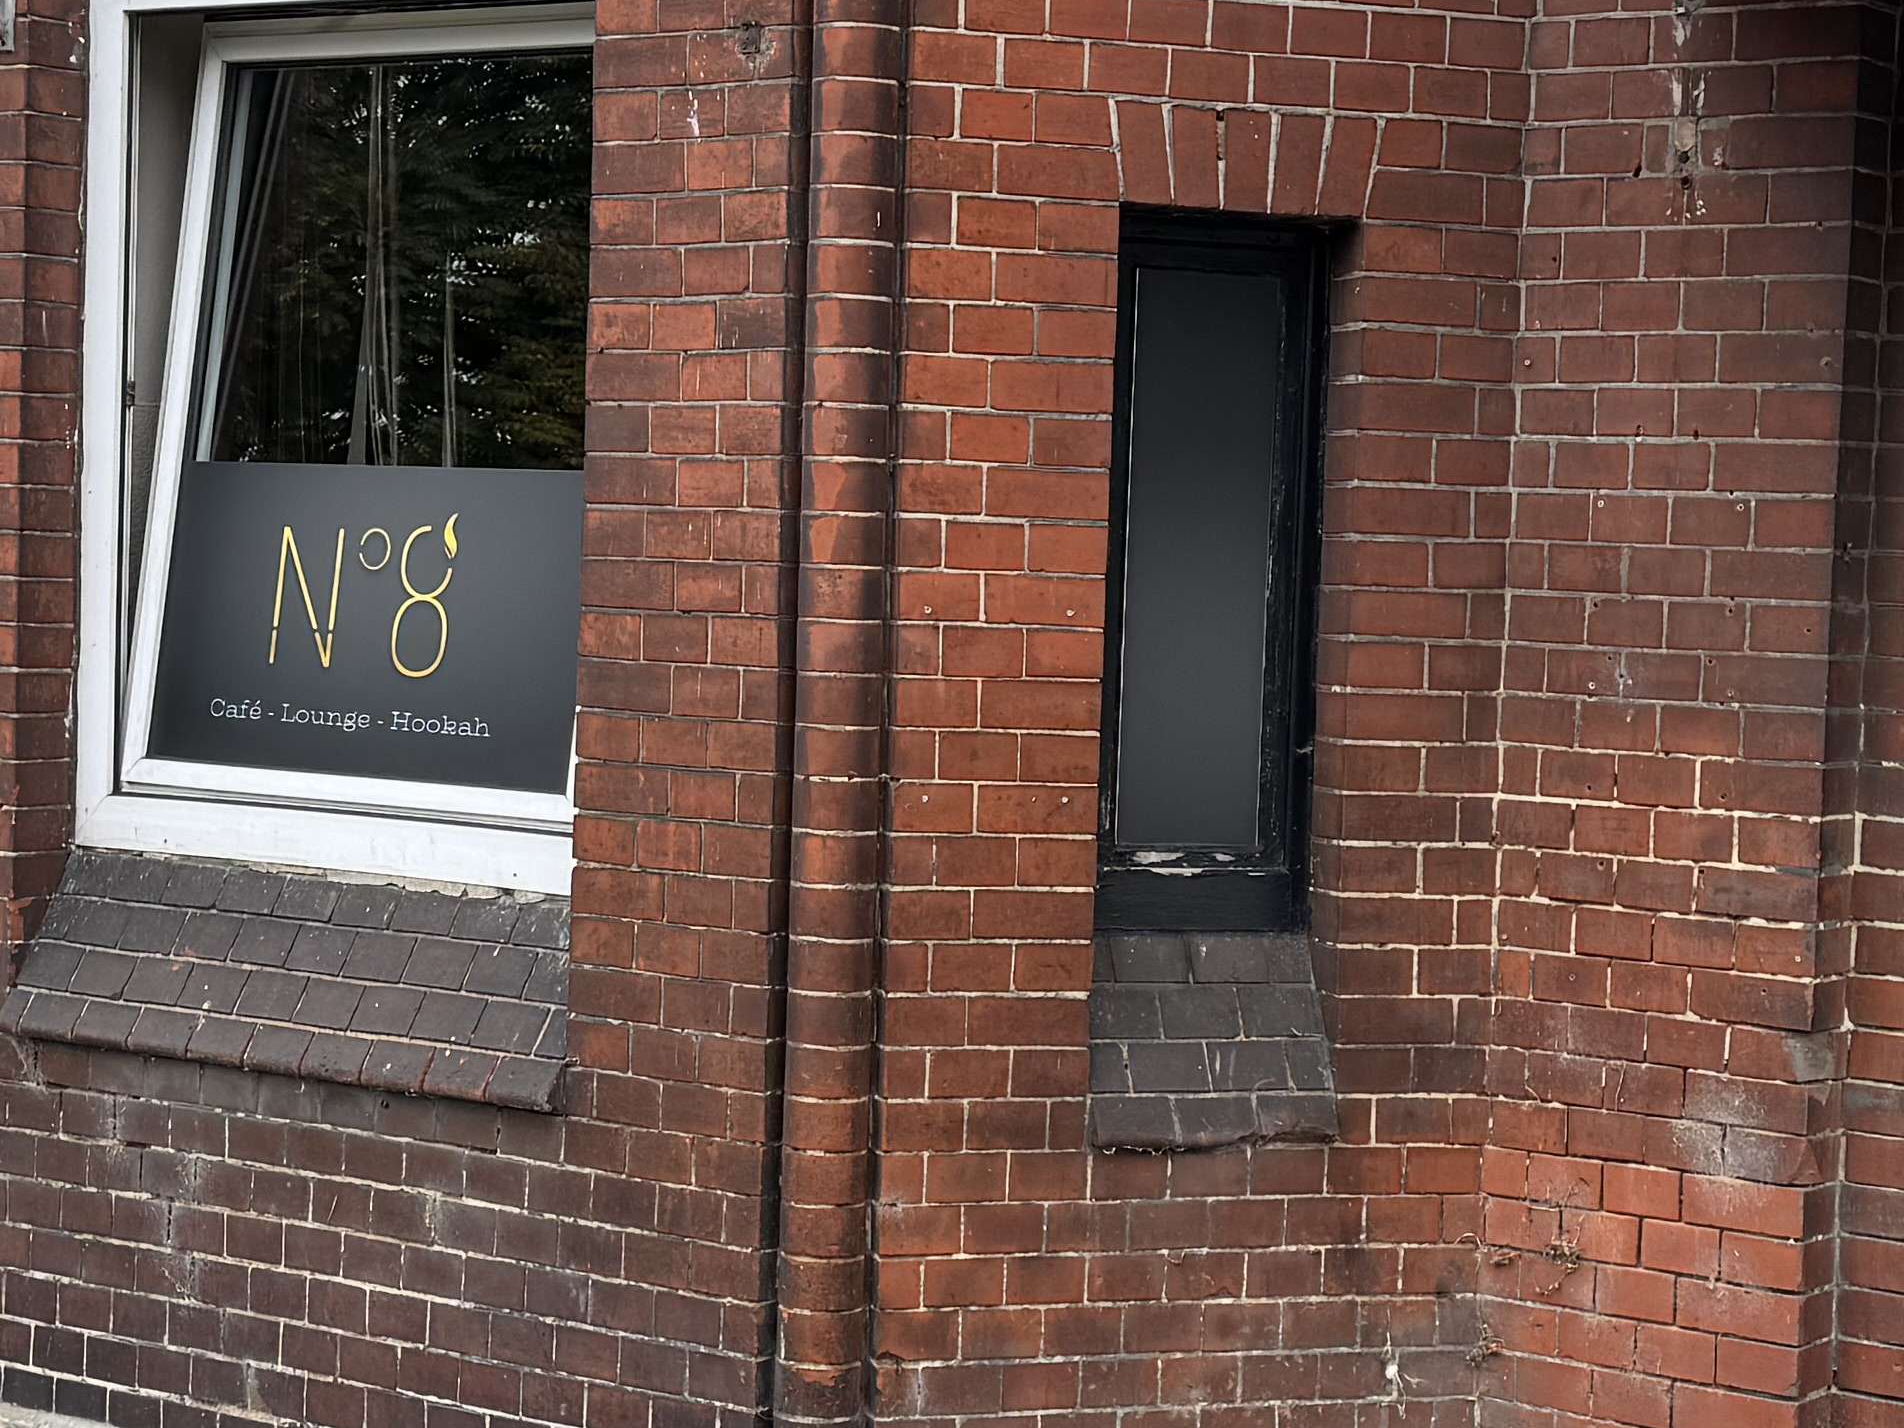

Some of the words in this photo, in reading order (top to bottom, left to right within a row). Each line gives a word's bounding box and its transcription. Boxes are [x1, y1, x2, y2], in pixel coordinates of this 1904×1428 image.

[210, 698, 262, 720] Café
[280, 703, 371, 732] Lounge
[390, 711, 491, 737] Hookah
